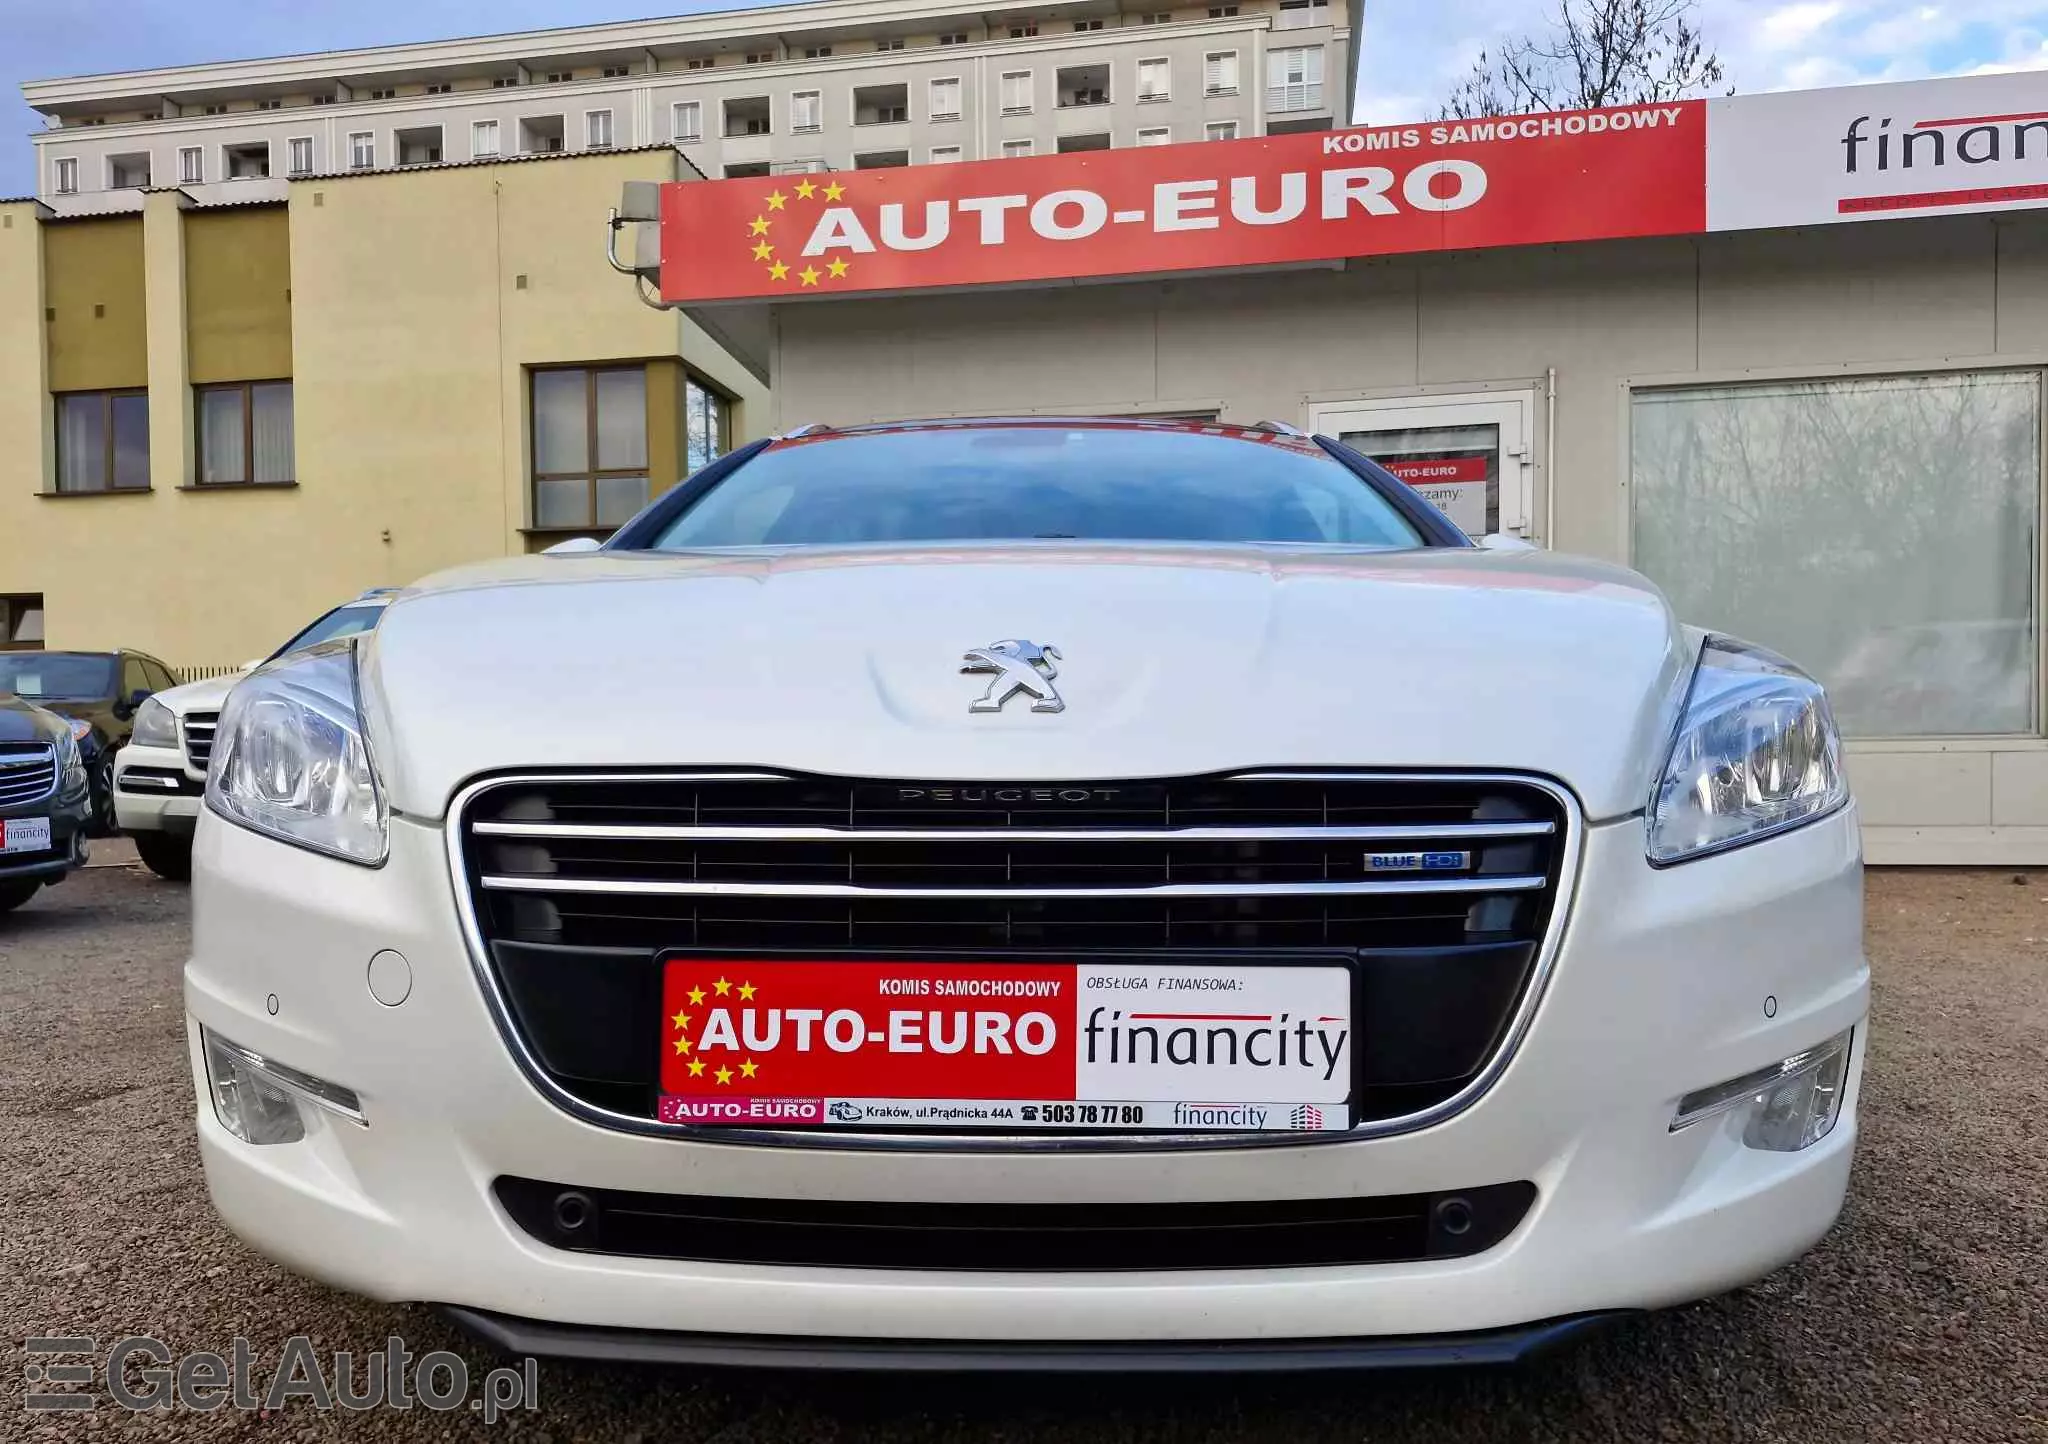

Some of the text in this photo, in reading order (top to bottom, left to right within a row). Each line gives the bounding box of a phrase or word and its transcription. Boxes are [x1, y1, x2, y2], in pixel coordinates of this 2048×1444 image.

[1322, 106, 1683, 155] KOMIS SAMOCHODOWY
[800, 158, 1489, 258] AUTO-EURO
[899, 789, 1121, 802] PEUGEOT
[1372, 855, 1416, 867] BLUE
[879, 979, 1061, 998] KOMIS SAMOCHODOWY
[1086, 976, 1244, 992] OBSŁUGA FINANSOWA:
[697, 1008, 1057, 1056] AUTO-EURO
[1084, 1006, 1348, 1081] financity
[675, 1103, 817, 1118] AUTO-EURO
[866, 1106, 912, 1119] Kraków,
[991, 1108, 1013, 1119] 44A
[1042, 1105, 1144, 1125] 503 78 77 80
[1174, 1102, 1268, 1129] financity
